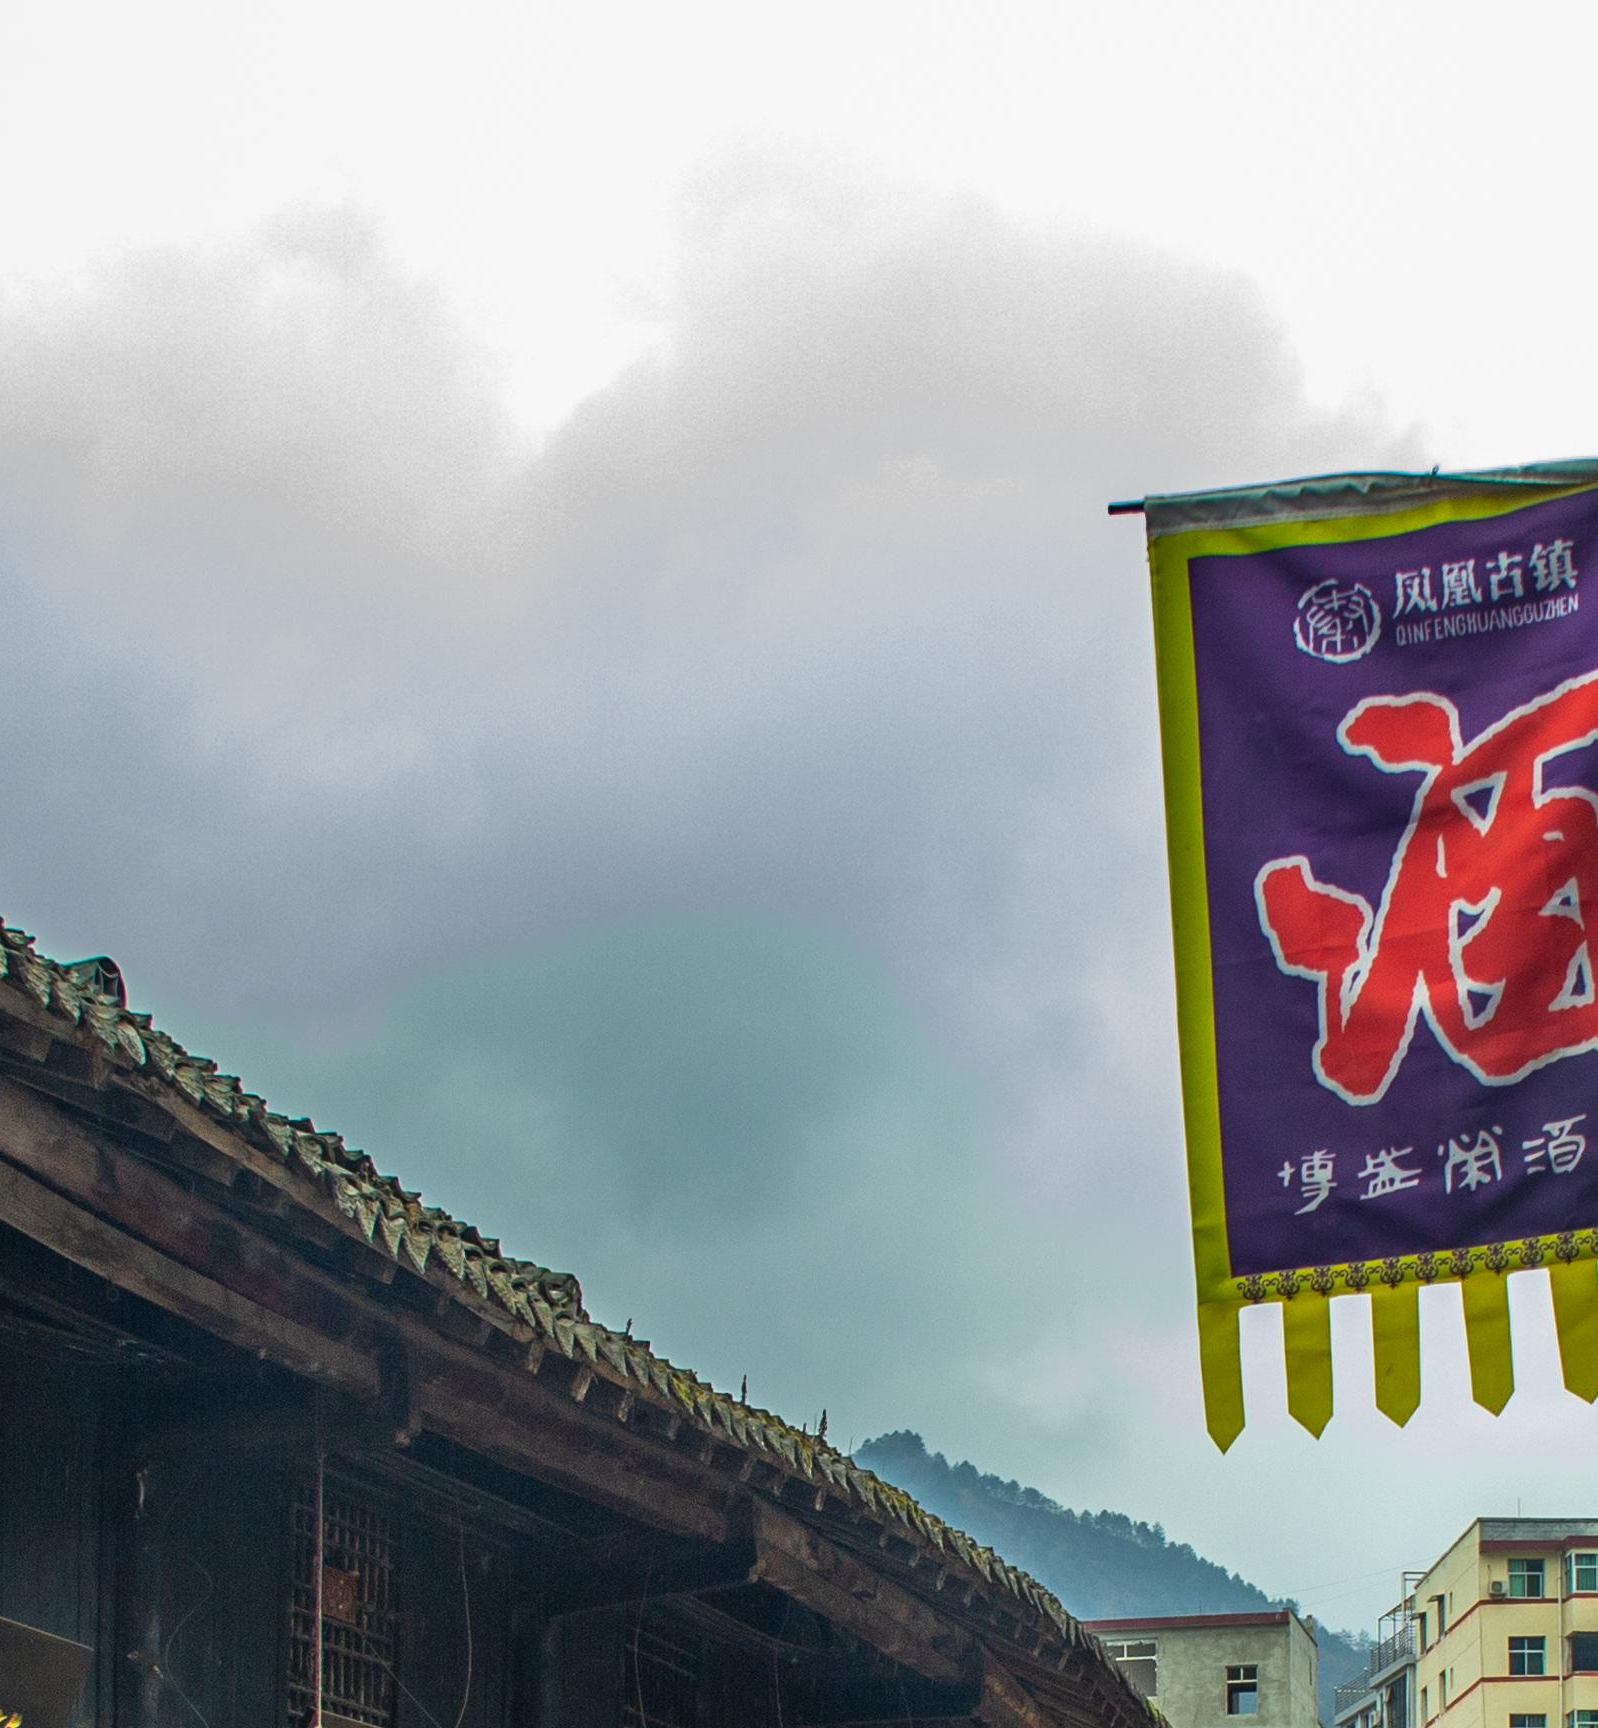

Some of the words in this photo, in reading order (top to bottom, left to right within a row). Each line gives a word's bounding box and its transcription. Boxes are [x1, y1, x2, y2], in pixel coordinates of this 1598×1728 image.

[1392, 538, 1580, 615] 凤凰古镇
[1394, 595, 1580, 647] QINFENGHUANGGUZHEN
